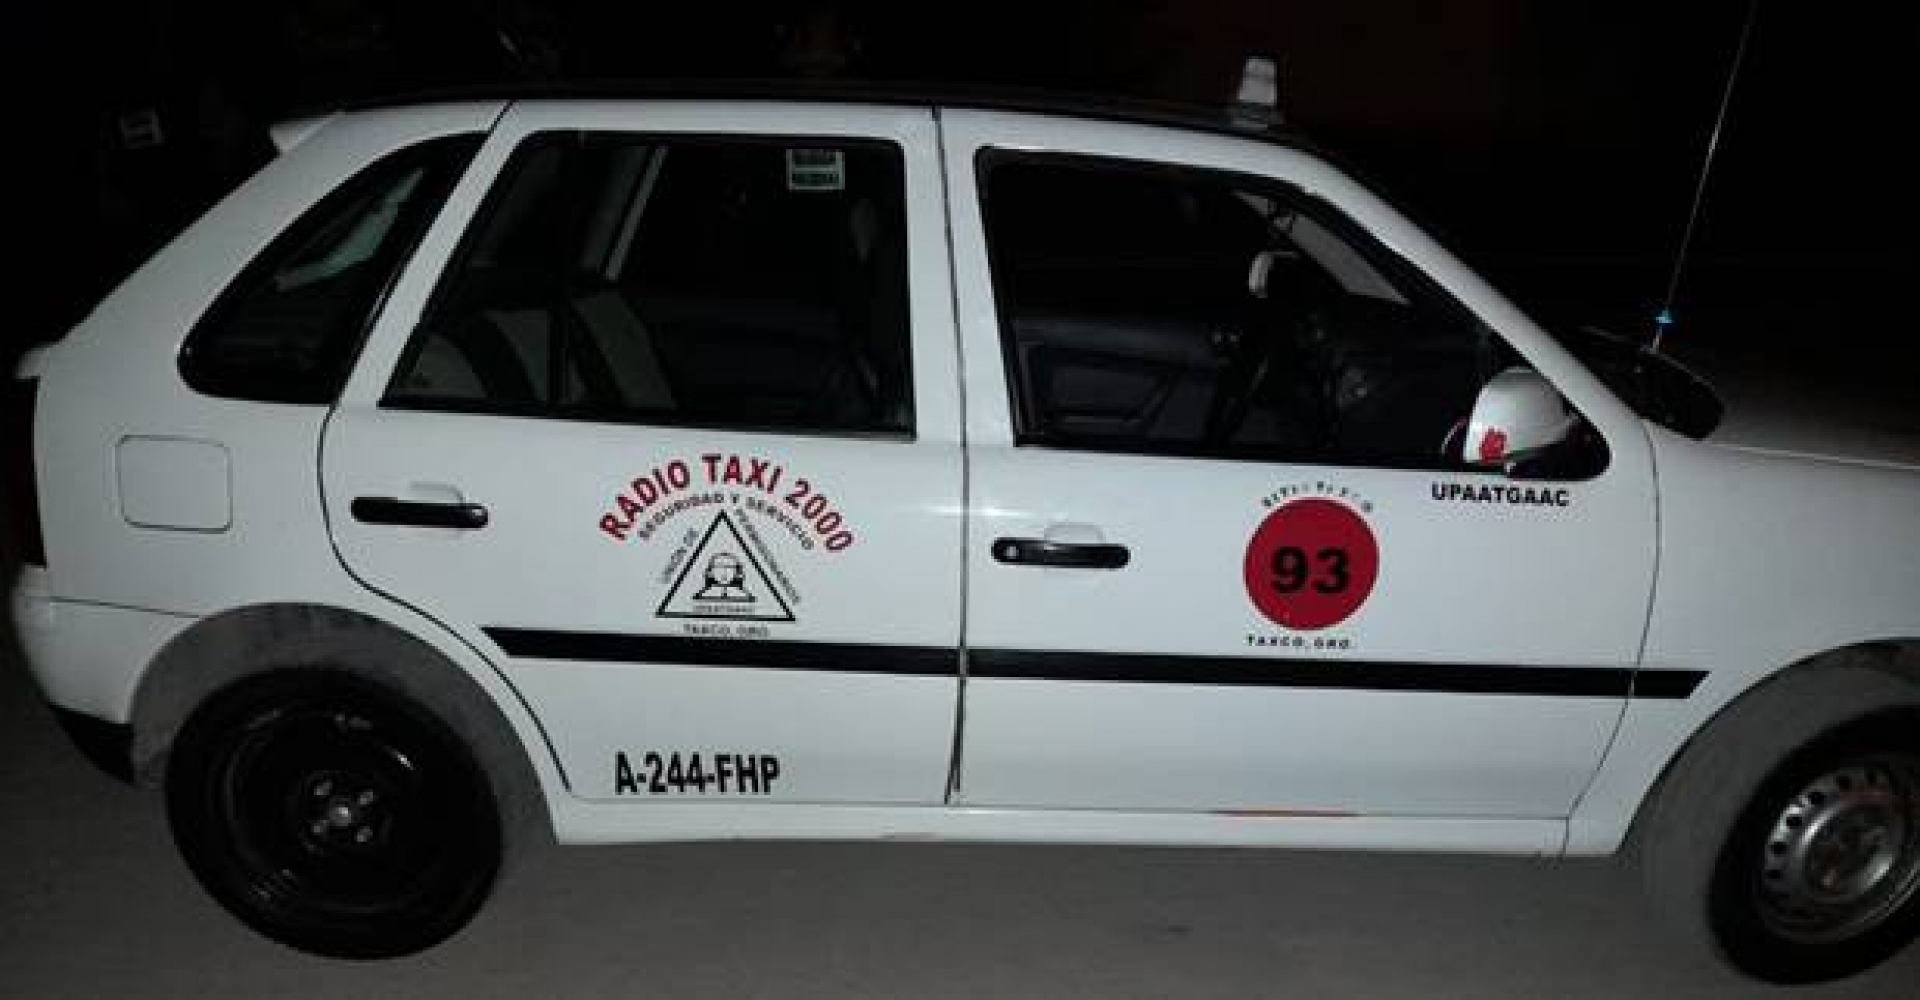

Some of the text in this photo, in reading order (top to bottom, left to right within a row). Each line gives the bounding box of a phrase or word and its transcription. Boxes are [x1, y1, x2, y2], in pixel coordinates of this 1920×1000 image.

[599, 453, 853, 553] RADIO TAXI 2000
[1431, 481, 1570, 508] UPAATGAAC
[637, 493, 815, 551] SEGURIDAD Y SERVICIO
[1270, 545, 1350, 595] 93
[615, 751, 780, 795] A-244-FHP
